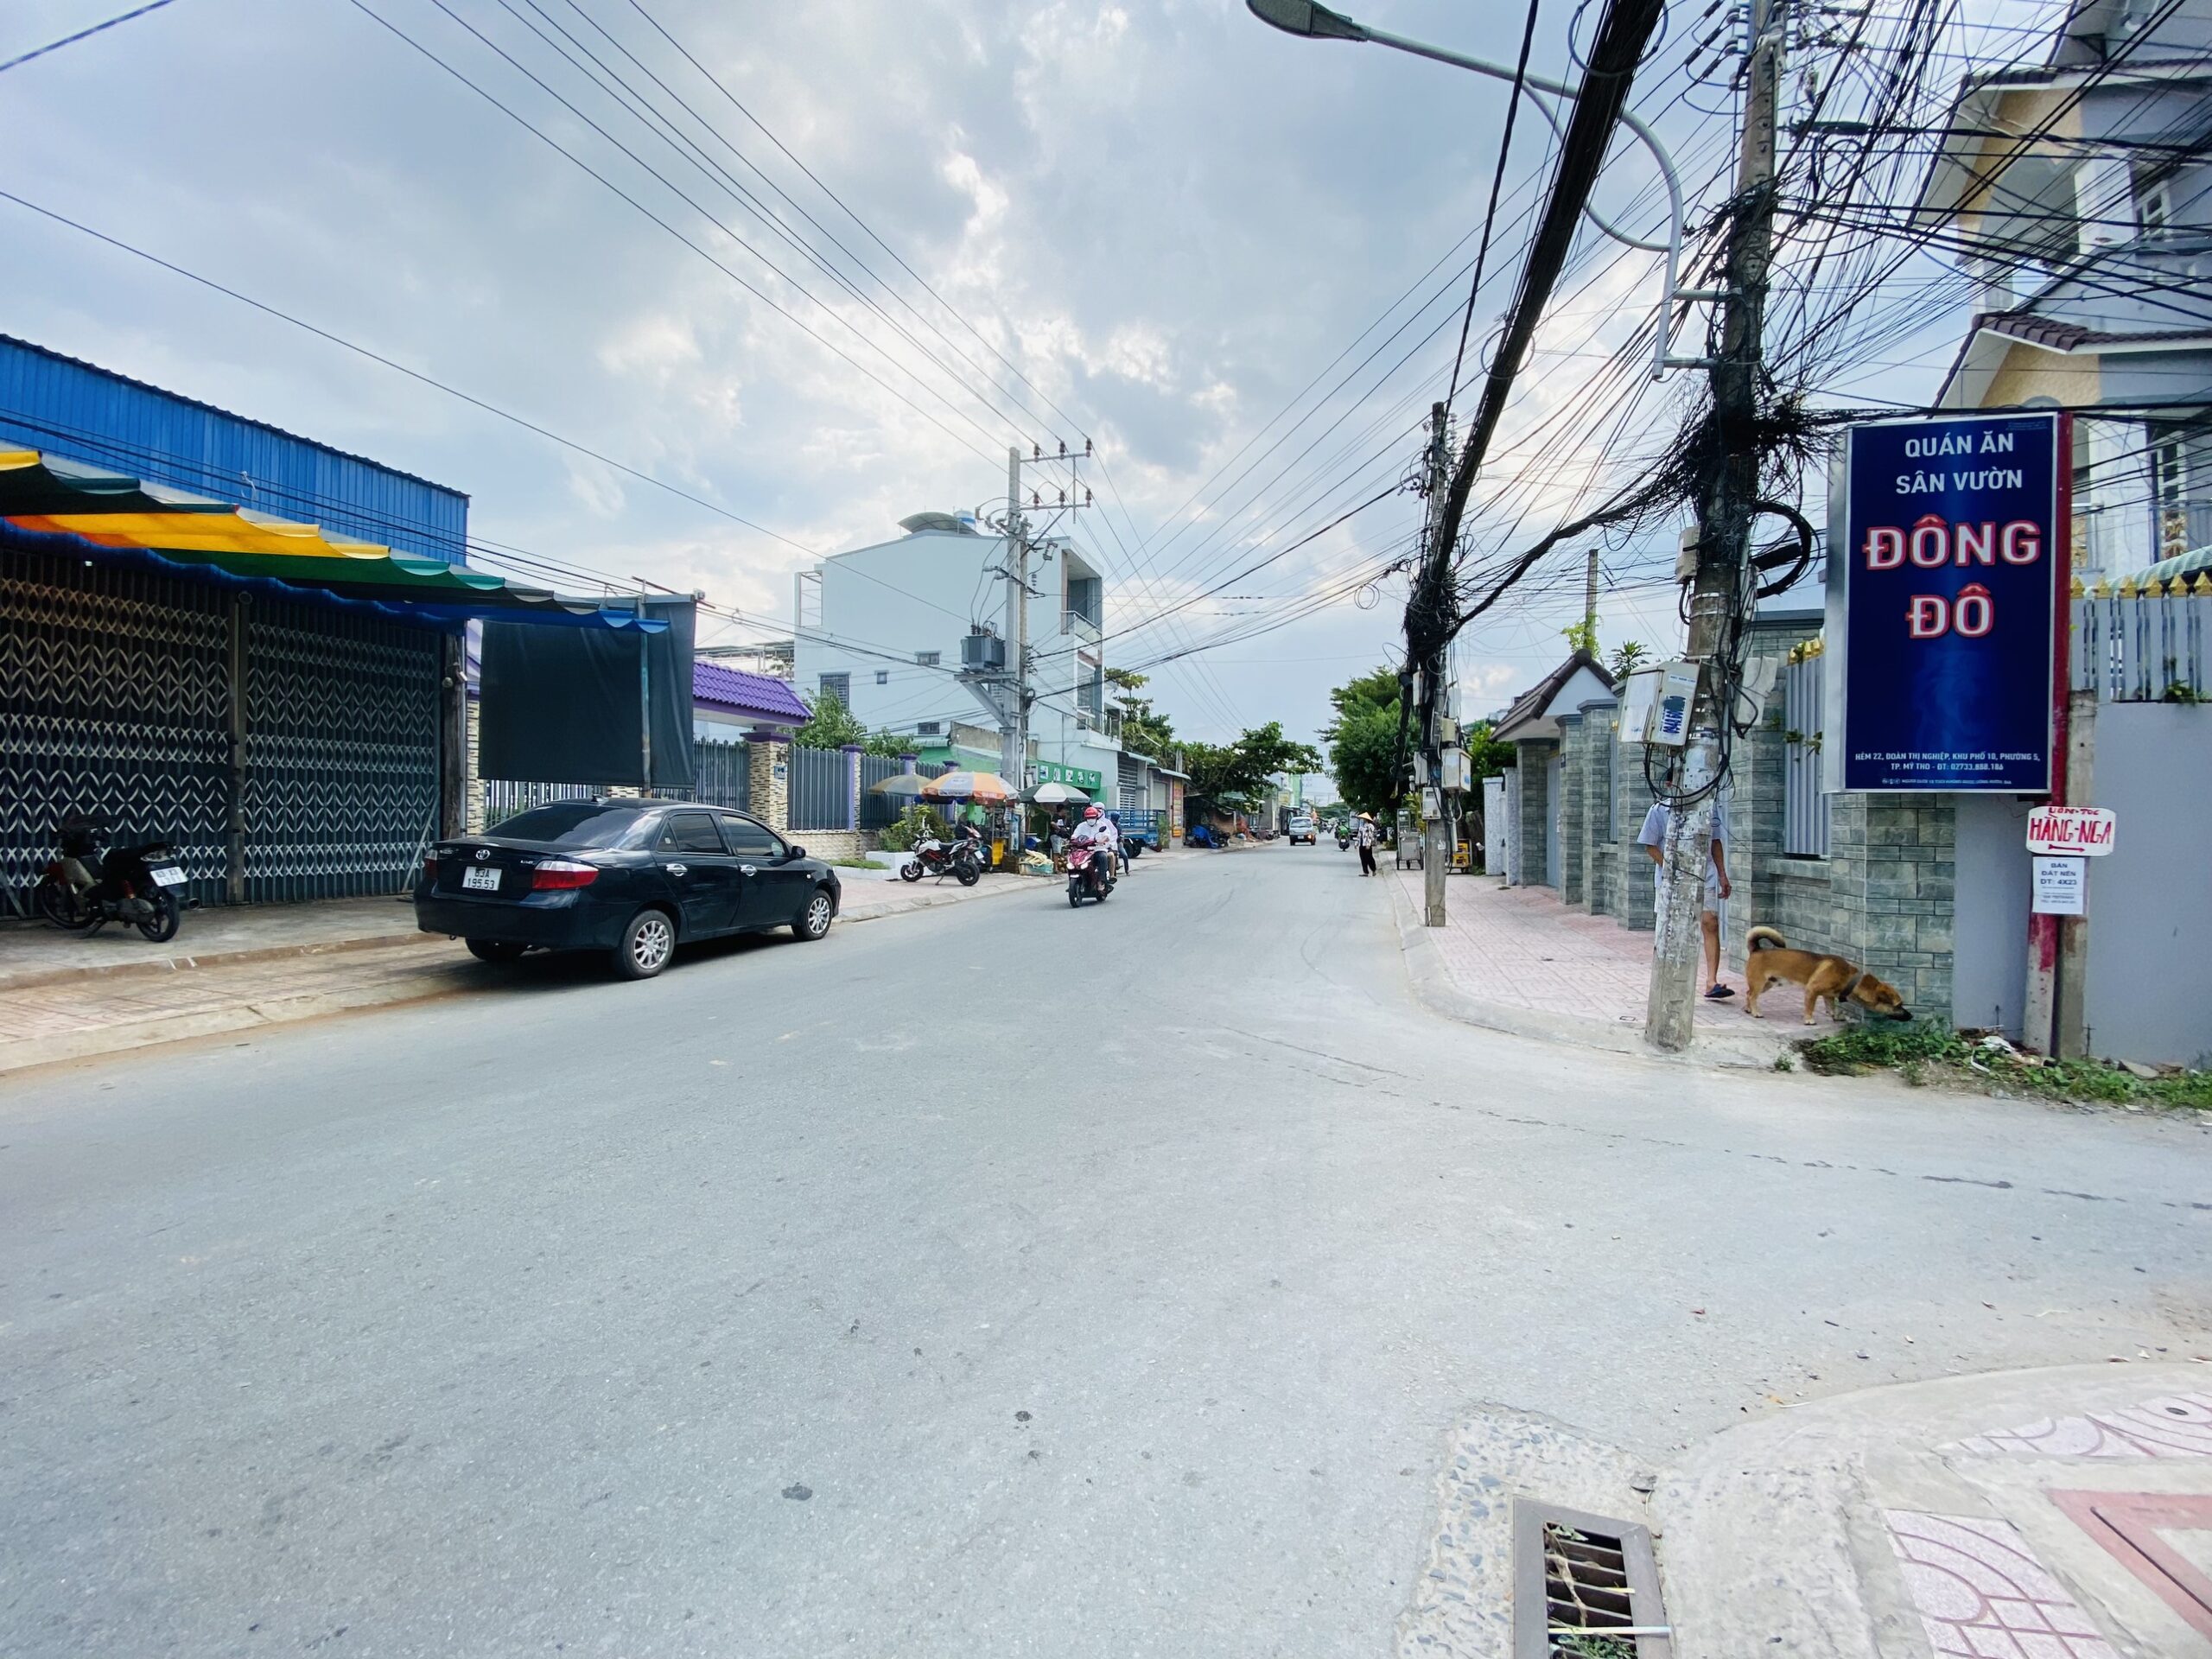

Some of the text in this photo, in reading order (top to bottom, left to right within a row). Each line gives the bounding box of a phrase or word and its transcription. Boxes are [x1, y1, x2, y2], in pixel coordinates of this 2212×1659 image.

[1904, 430, 2014, 458] QUÁN ĂN
[1896, 467, 2023, 494] SÂN VƯỜN
[1862, 514, 2041, 570] ĐÔNG
[1905, 582, 1994, 639] ĐÔ
